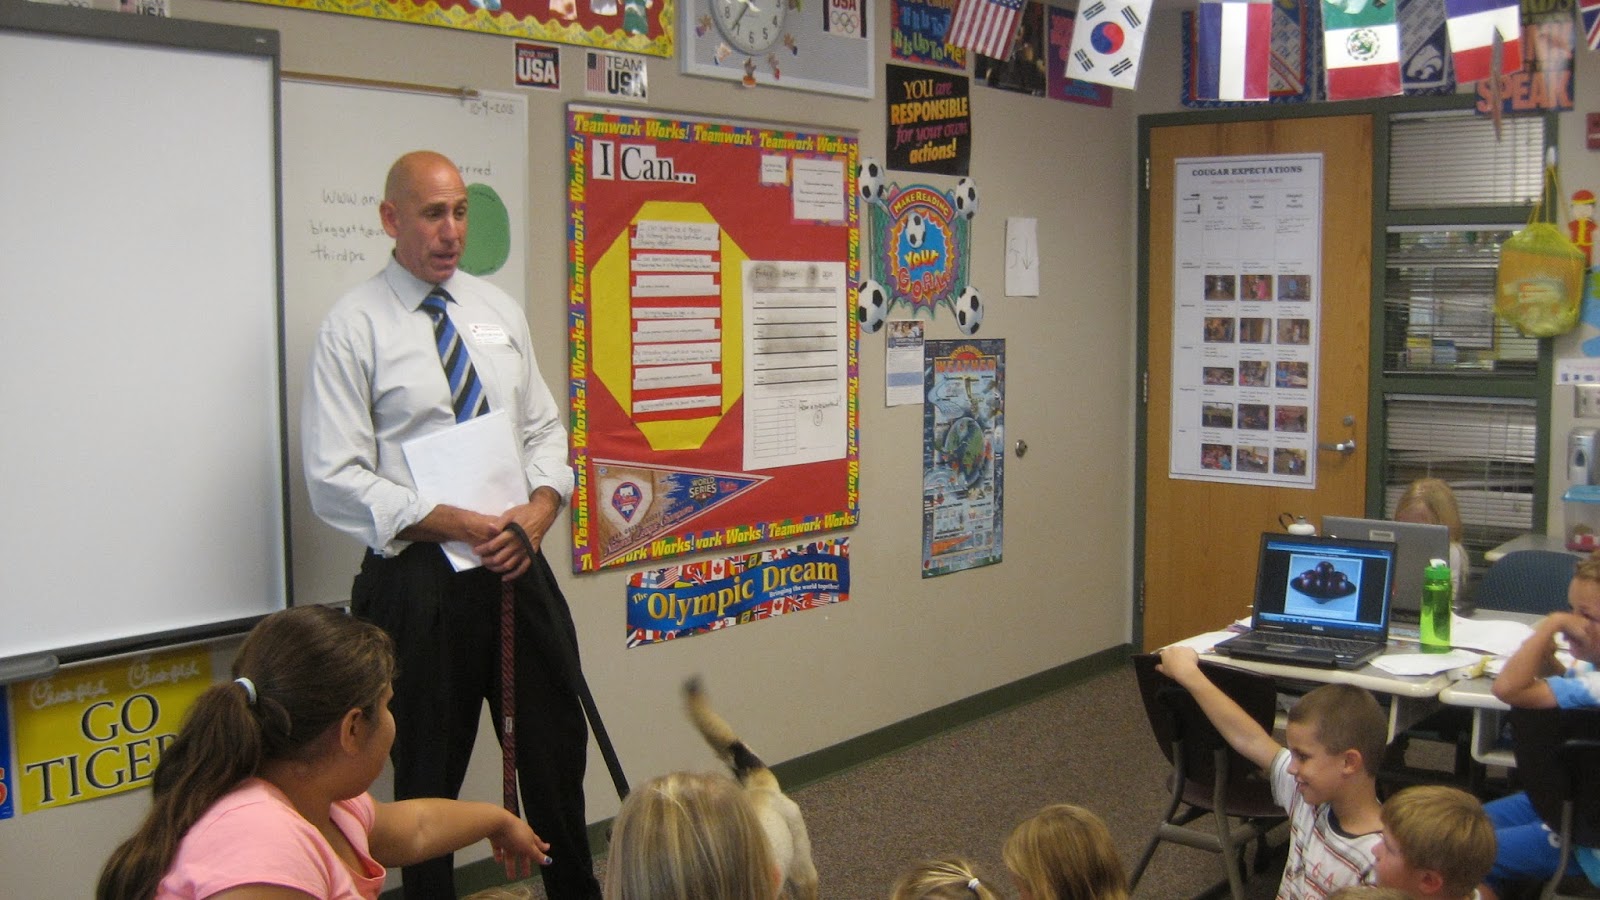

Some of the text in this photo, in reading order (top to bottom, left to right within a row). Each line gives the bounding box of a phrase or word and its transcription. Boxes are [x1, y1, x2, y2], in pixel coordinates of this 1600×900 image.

[762, 27, 769, 40] 5
[518, 57, 557, 84] USA
[606, 55, 643, 71] TEAM
[903, 79, 934, 100] YOU
[891, 97, 968, 126] RESPONSIBLE
[573, 114, 848, 153] Teamwork Works! Teamwork Teamwork Works
[893, 124, 914, 150] for
[915, 125, 944, 146] your
[600, 143, 696, 183] I Can...
[909, 137, 957, 165] actions!
[571, 135, 585, 201] Works!
[1192, 165, 1303, 177] COUGAR EXPECTATIONS
[571, 207, 586, 305] Teamwork
[572, 312, 585, 378] Works!
[573, 382, 587, 448] Works!
[689, 484, 717, 498] SERIES
[691, 476, 715, 487] WORLD
[575, 454, 588, 548] Teamwork
[651, 535, 695, 558] Works!
[726, 525, 765, 545] Works!
[768, 516, 821, 538] Teamwork
[824, 510, 859, 529] Works!
[633, 591, 648, 605] The
[647, 561, 839, 626] Olympic Dream
[81, 692, 160, 742] GO
